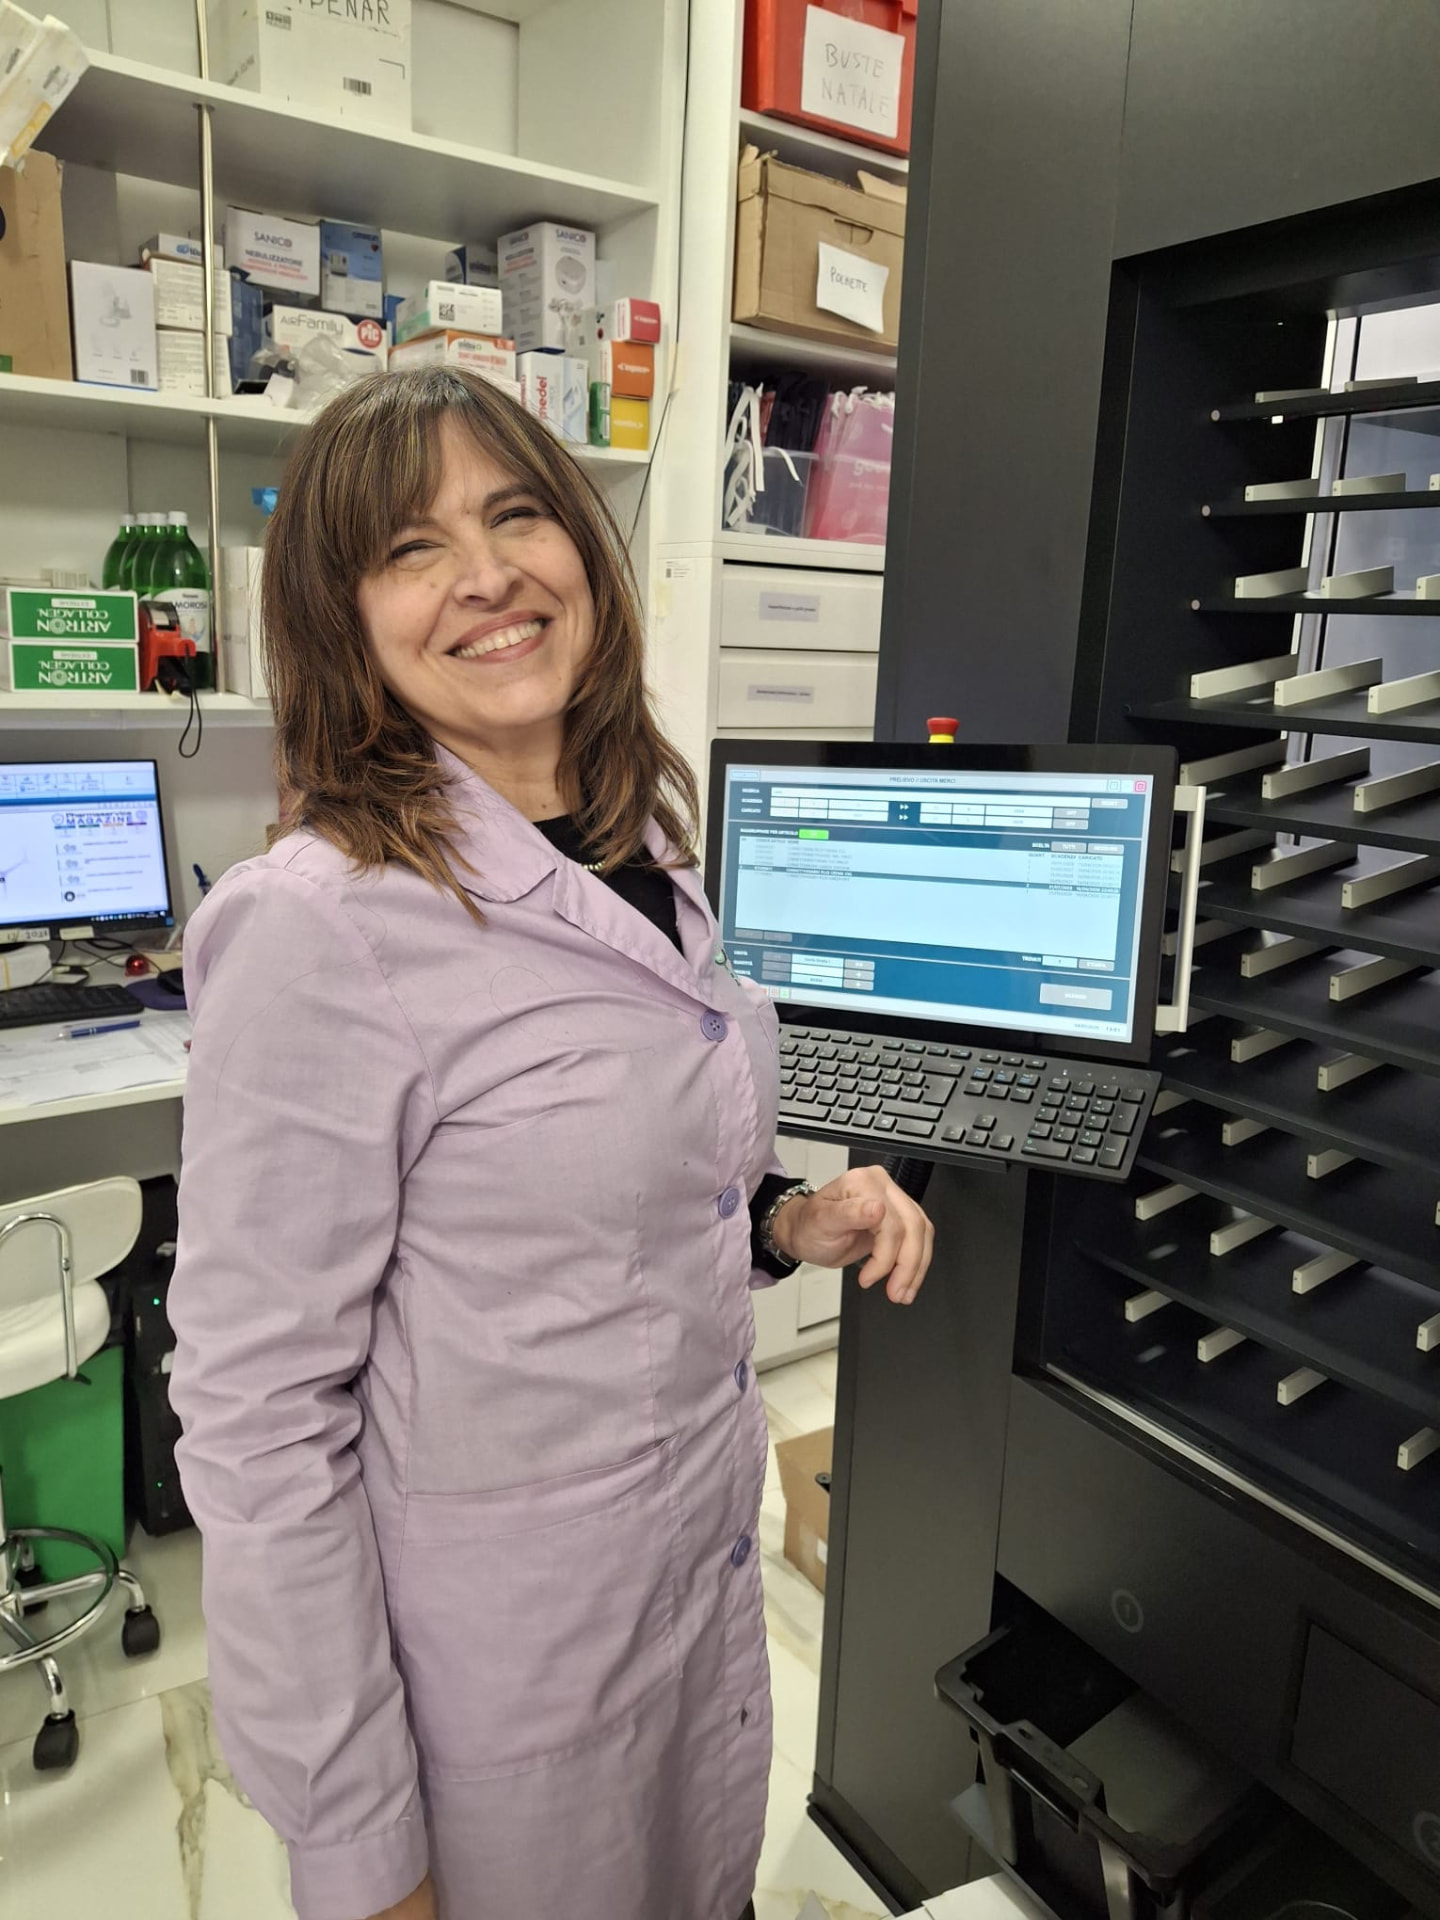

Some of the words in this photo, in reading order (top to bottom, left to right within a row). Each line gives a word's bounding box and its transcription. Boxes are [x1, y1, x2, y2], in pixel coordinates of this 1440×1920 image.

[825, 43, 884, 77] BUSTE
[822, 77, 889, 118] NATALE
[254, 231, 293, 248] SANICO
[830, 266, 869, 293] POCHETTE
[36, 619, 112, 635] ARTRON
[38, 670, 113, 686] ARTRON
